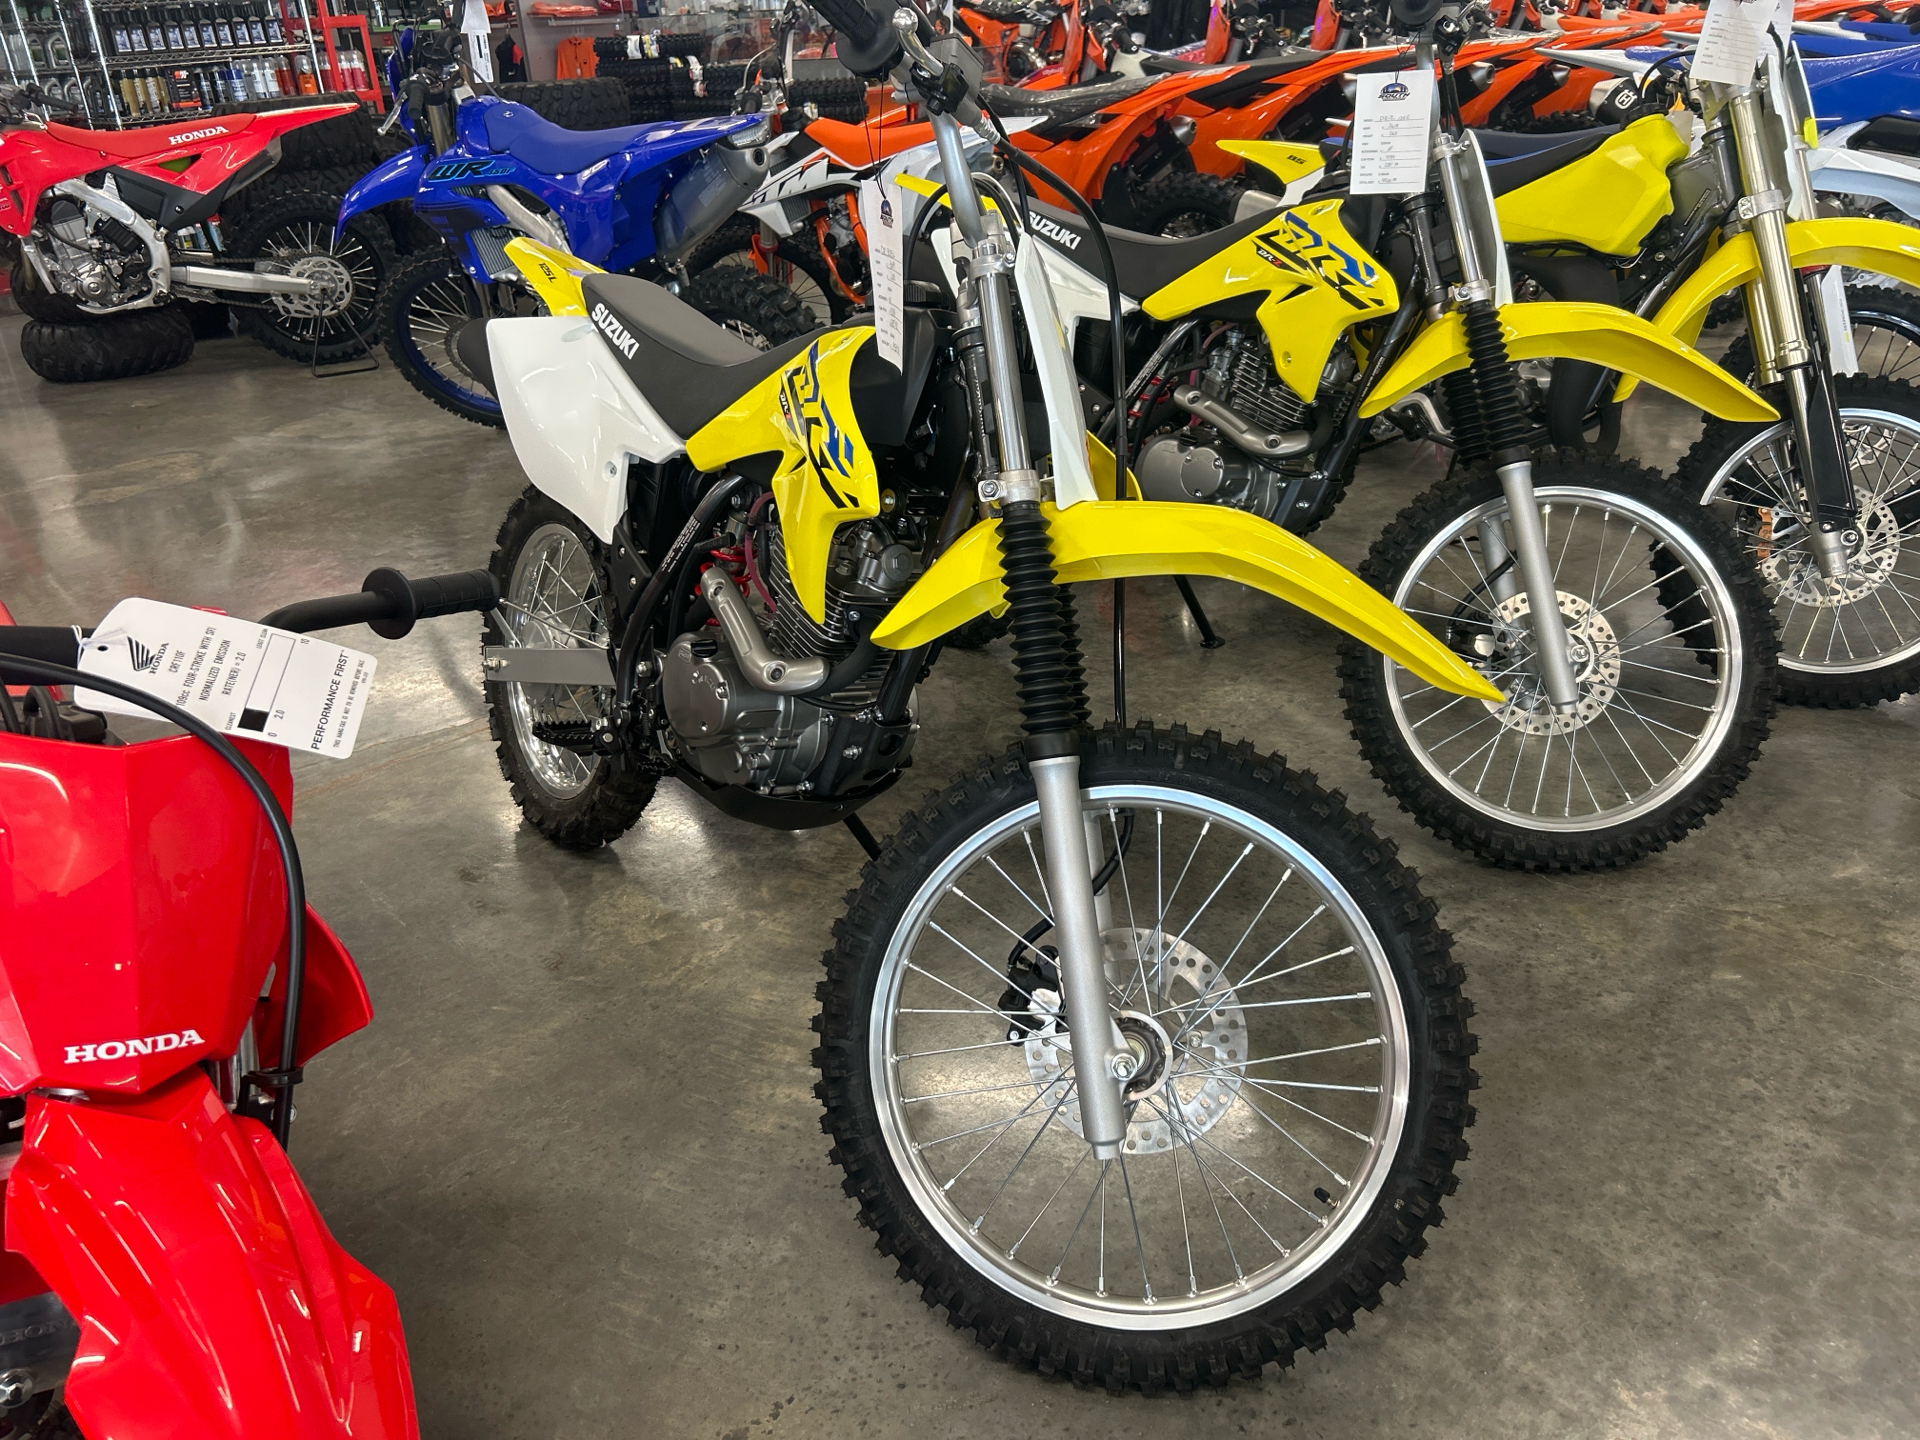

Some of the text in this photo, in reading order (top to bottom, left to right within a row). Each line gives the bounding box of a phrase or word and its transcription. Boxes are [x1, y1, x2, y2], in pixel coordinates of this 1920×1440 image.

[168, 124, 229, 146] HONDA
[538, 262, 557, 283] 125L
[1257, 248, 1283, 267] DR-Z
[592, 302, 640, 360] SUZUKI
[149, 641, 170, 676] HONDA
[168, 650, 186, 673] CRF110F
[176, 689, 190, 706] 109cc
[183, 650, 206, 687] FOUR-STROKE
[199, 635, 212, 650] WITH
[199, 639, 231, 701] NORMALIZED EMISSION
[222, 667, 241, 695] RATE(NER)
[235, 651, 246, 661] 2.0
[274, 709, 285, 719] 2.0
[311, 678, 341, 750] PERFORMANCE
[64, 1029, 205, 1064] HONDA
